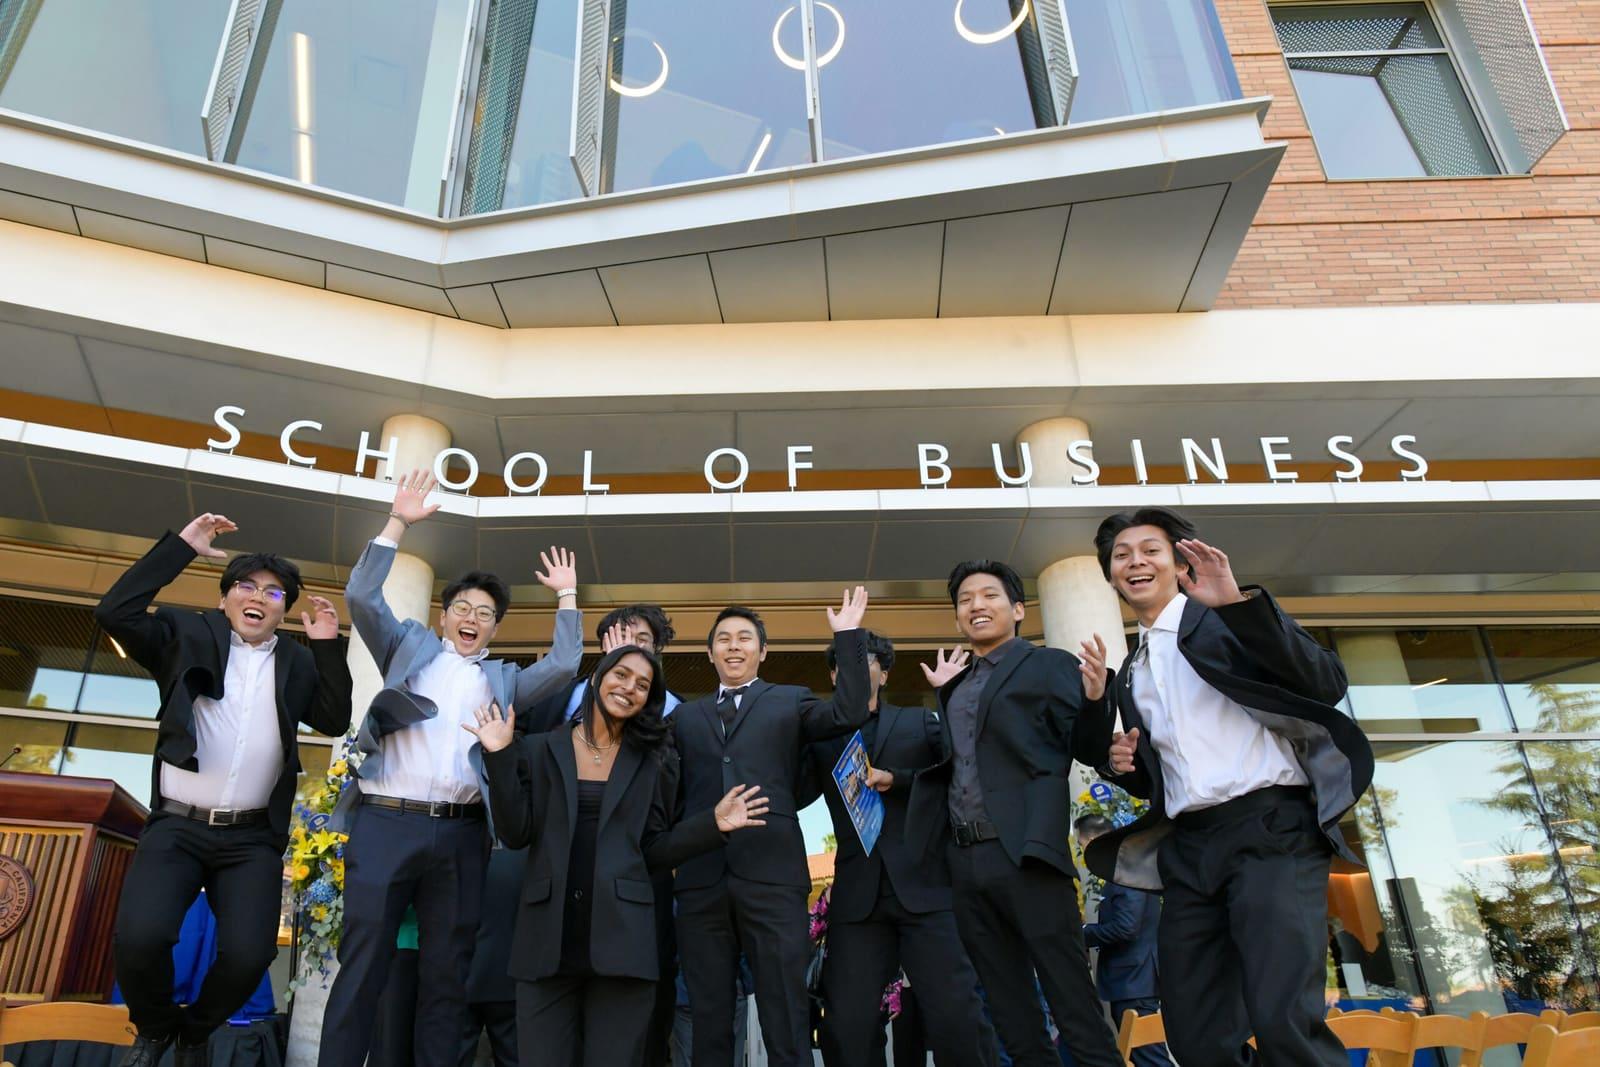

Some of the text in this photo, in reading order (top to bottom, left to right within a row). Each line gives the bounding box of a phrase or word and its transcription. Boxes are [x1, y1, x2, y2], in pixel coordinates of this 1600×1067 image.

[206, 405, 1429, 493] SCHOOL OF BUSINESS
[1, 870, 26, 929] CALIFORNIA
